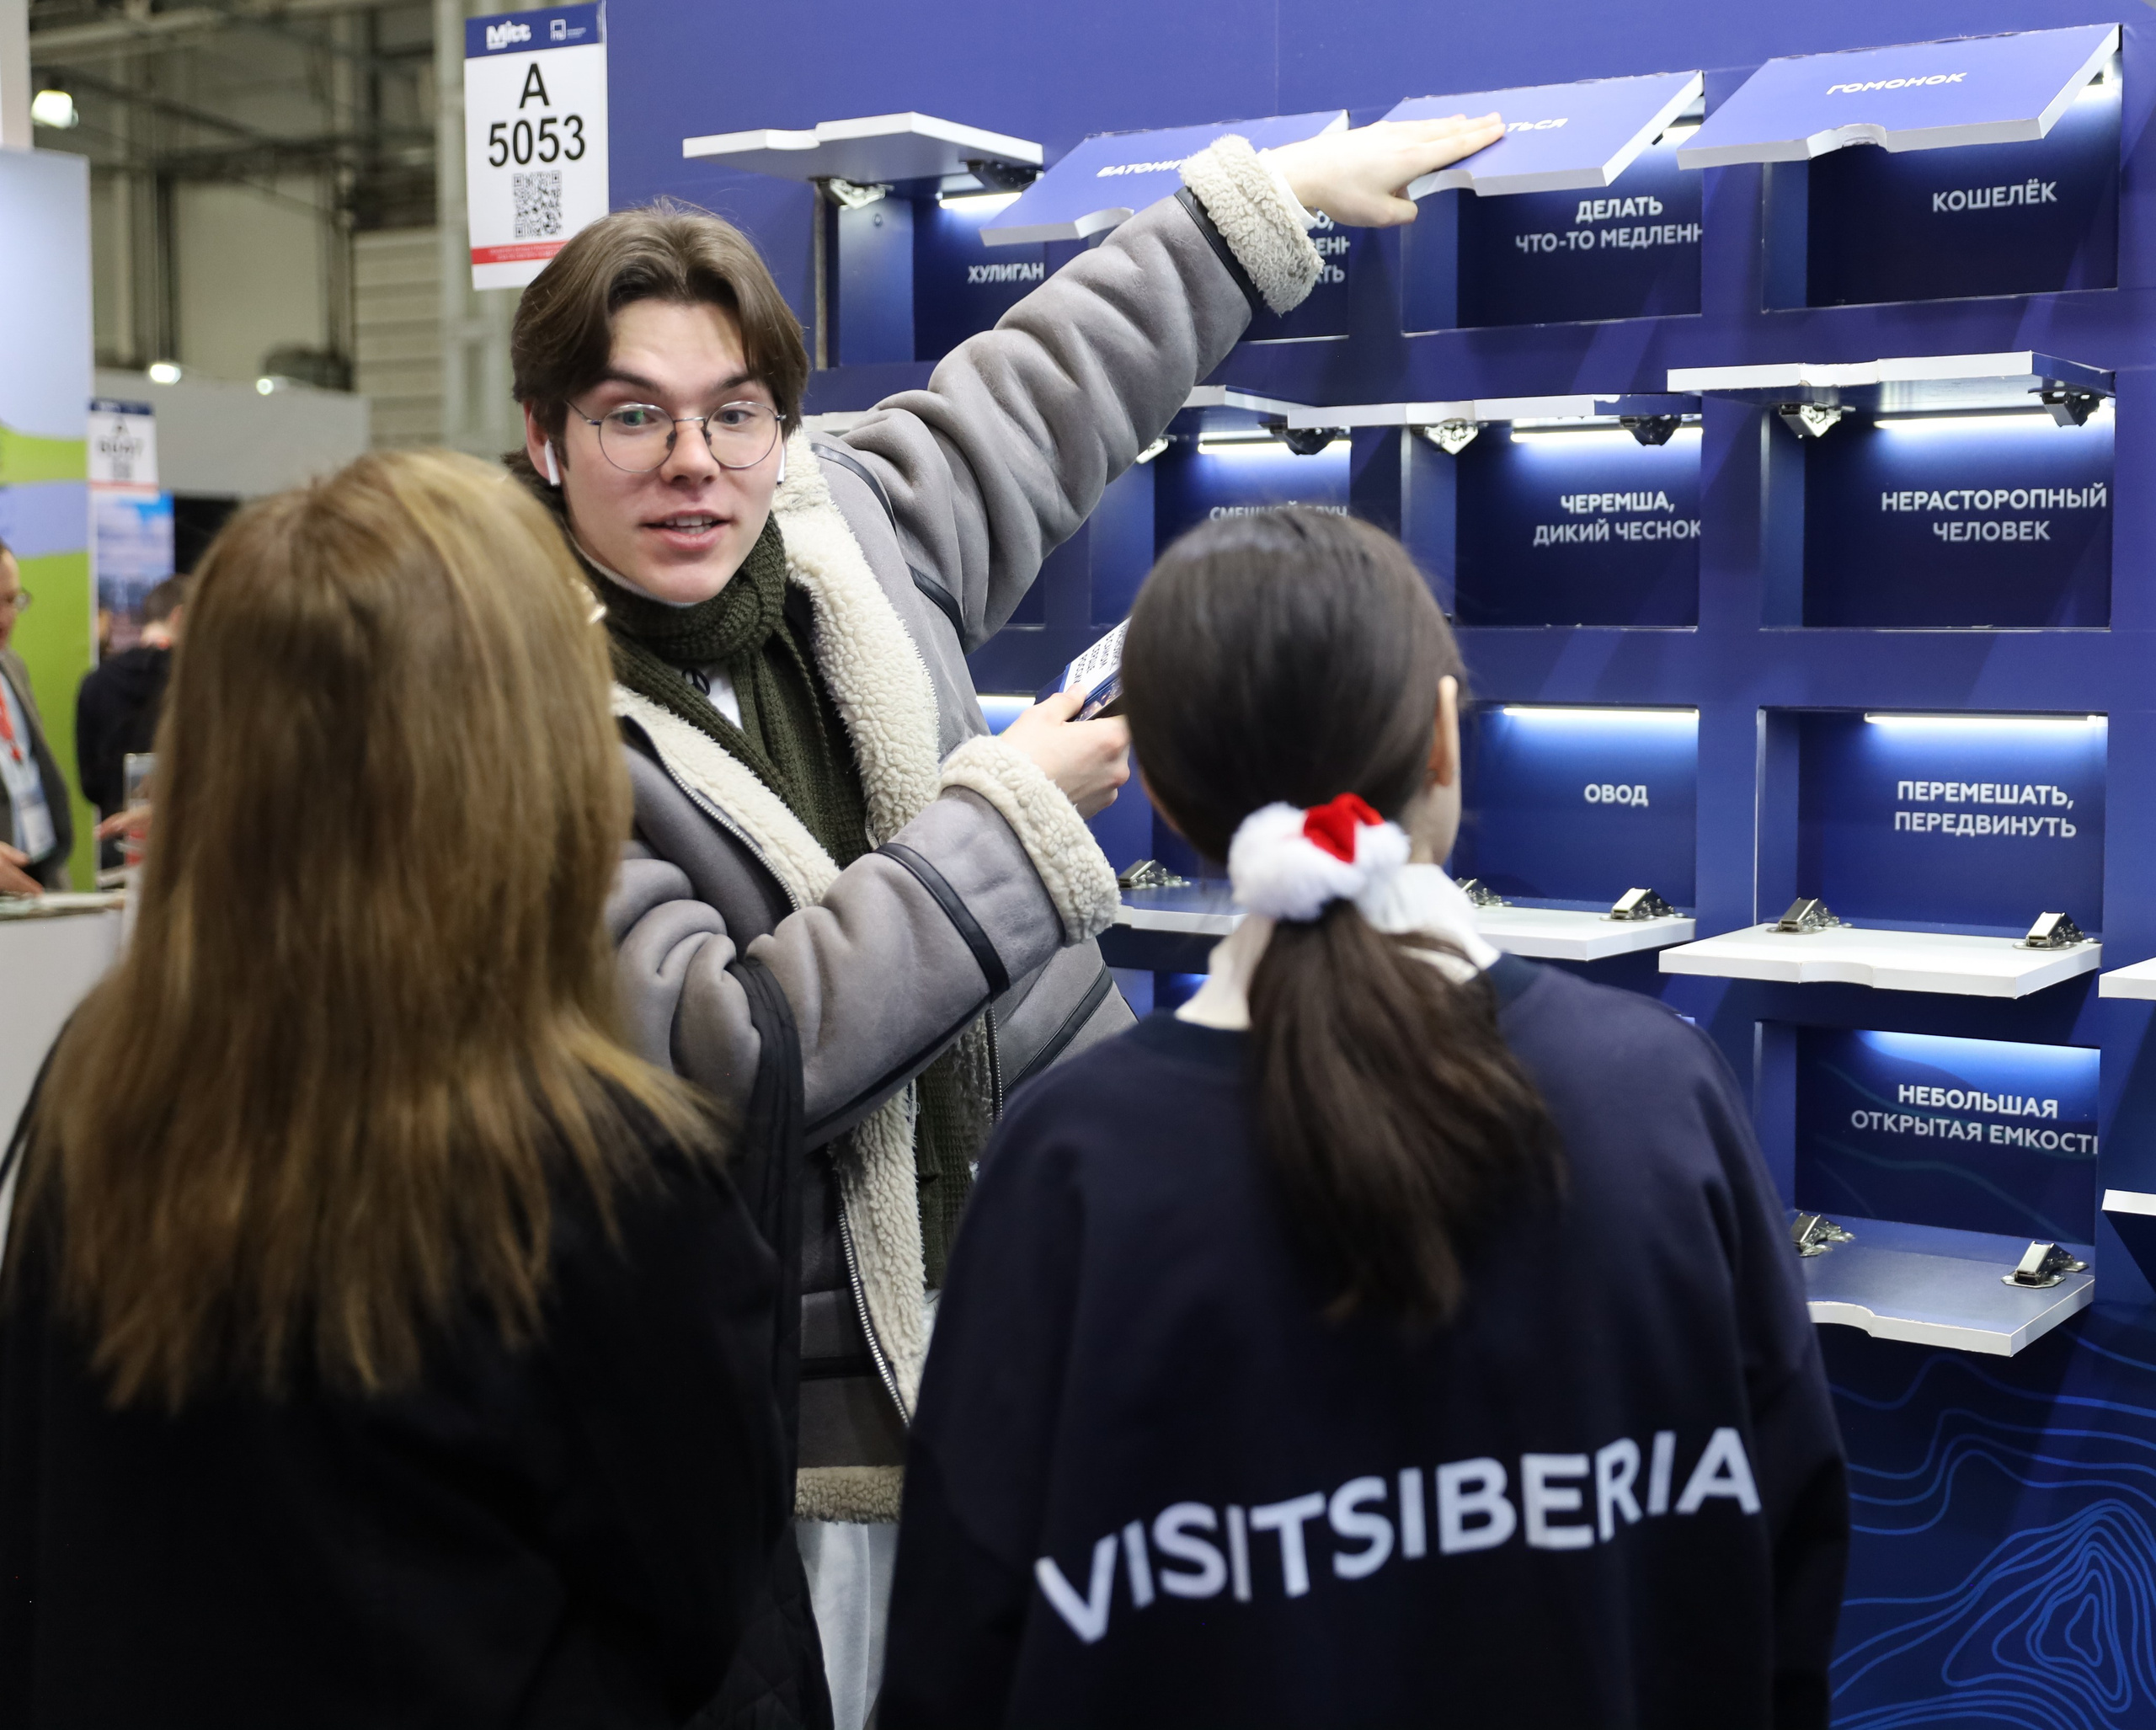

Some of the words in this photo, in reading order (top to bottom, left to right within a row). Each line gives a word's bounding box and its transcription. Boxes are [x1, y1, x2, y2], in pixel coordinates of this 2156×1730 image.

[519, 63, 550, 109] A
[1826, 72, 1967, 94] ГОМОНОК
[1507, 118, 1568, 132] ТЬСЯ
[488, 115, 585, 167] 5053
[1097, 159, 1181, 178] БАТОНИ
[1933, 178, 2057, 212] КОШЕЛЁК
[1575, 196, 1663, 224] ДЕЛАТЬ
[1515, 230, 1595, 253] ЧТО-ТО
[967, 262, 1044, 284] ХУЛИГАН
[1561, 491, 1675, 514] ЧЕРЕМША,
[1881, 483, 2107, 511] НЕРАСТОРОПНЫЙ
[1533, 518, 1609, 547] ДИКИЙ
[1614, 519, 1701, 541] ЧЕСНОК
[1933, 521, 2051, 542] ЧЕЛОВЕК
[1584, 783, 1648, 807] ОВОД
[1897, 780, 2075, 809] ПЕРЕМЕШАТЬ,
[1894, 811, 2077, 838] ПЕРЕДВИНУТЬ
[1898, 1084, 2058, 1119] НЕБОЛЬШАЯ
[1851, 1109, 1983, 1141] ОТКРЫТАЯ
[1035, 1427, 1762, 1644] VISITSIBERIA
